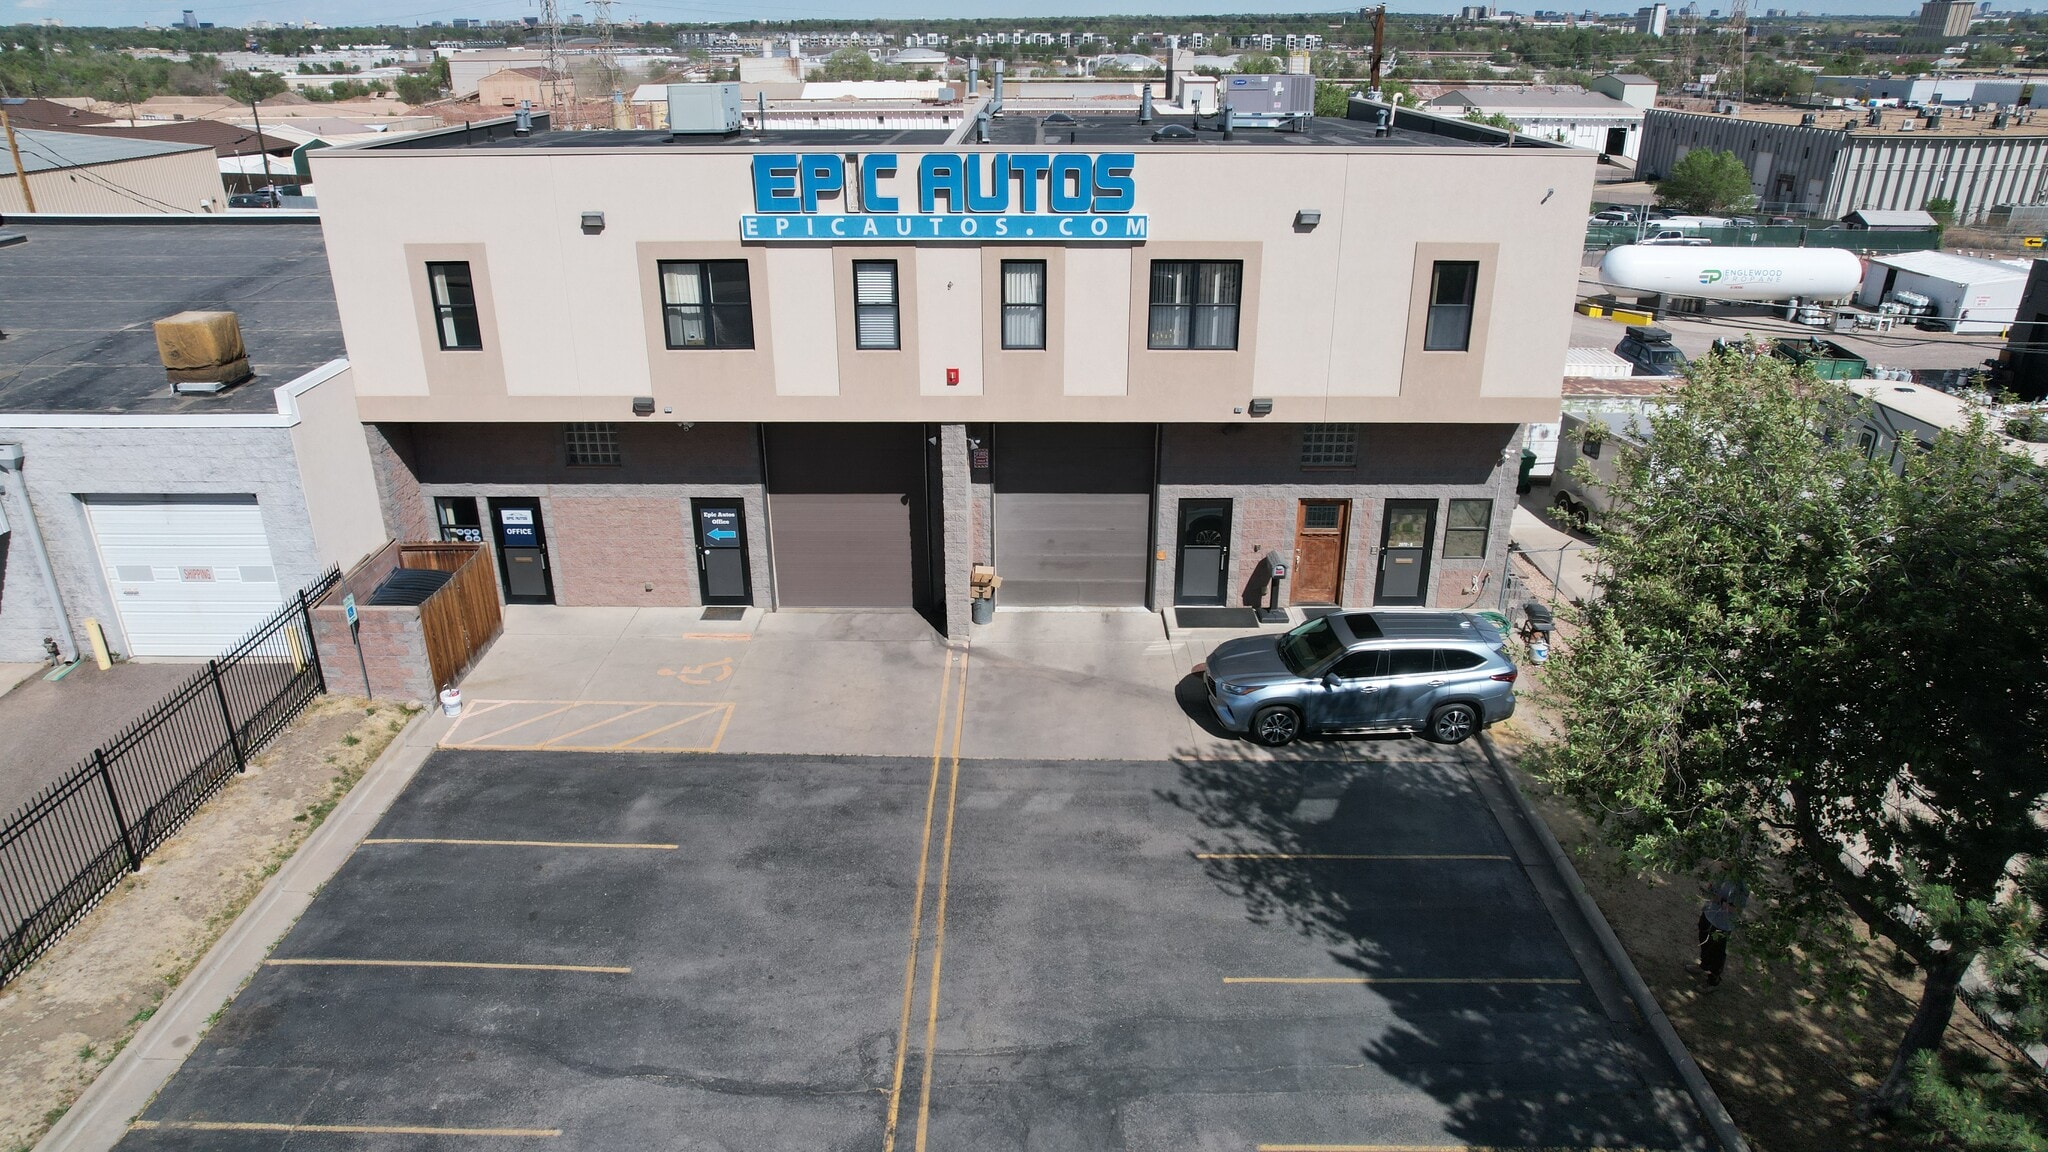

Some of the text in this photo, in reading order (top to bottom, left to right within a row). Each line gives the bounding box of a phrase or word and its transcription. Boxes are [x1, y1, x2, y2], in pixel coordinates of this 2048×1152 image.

[752, 153, 1135, 213] EPIC AUTOS
[746, 216, 1146, 237] EPICAUTOS.COM
[184, 568, 211, 579] SHIPPING
